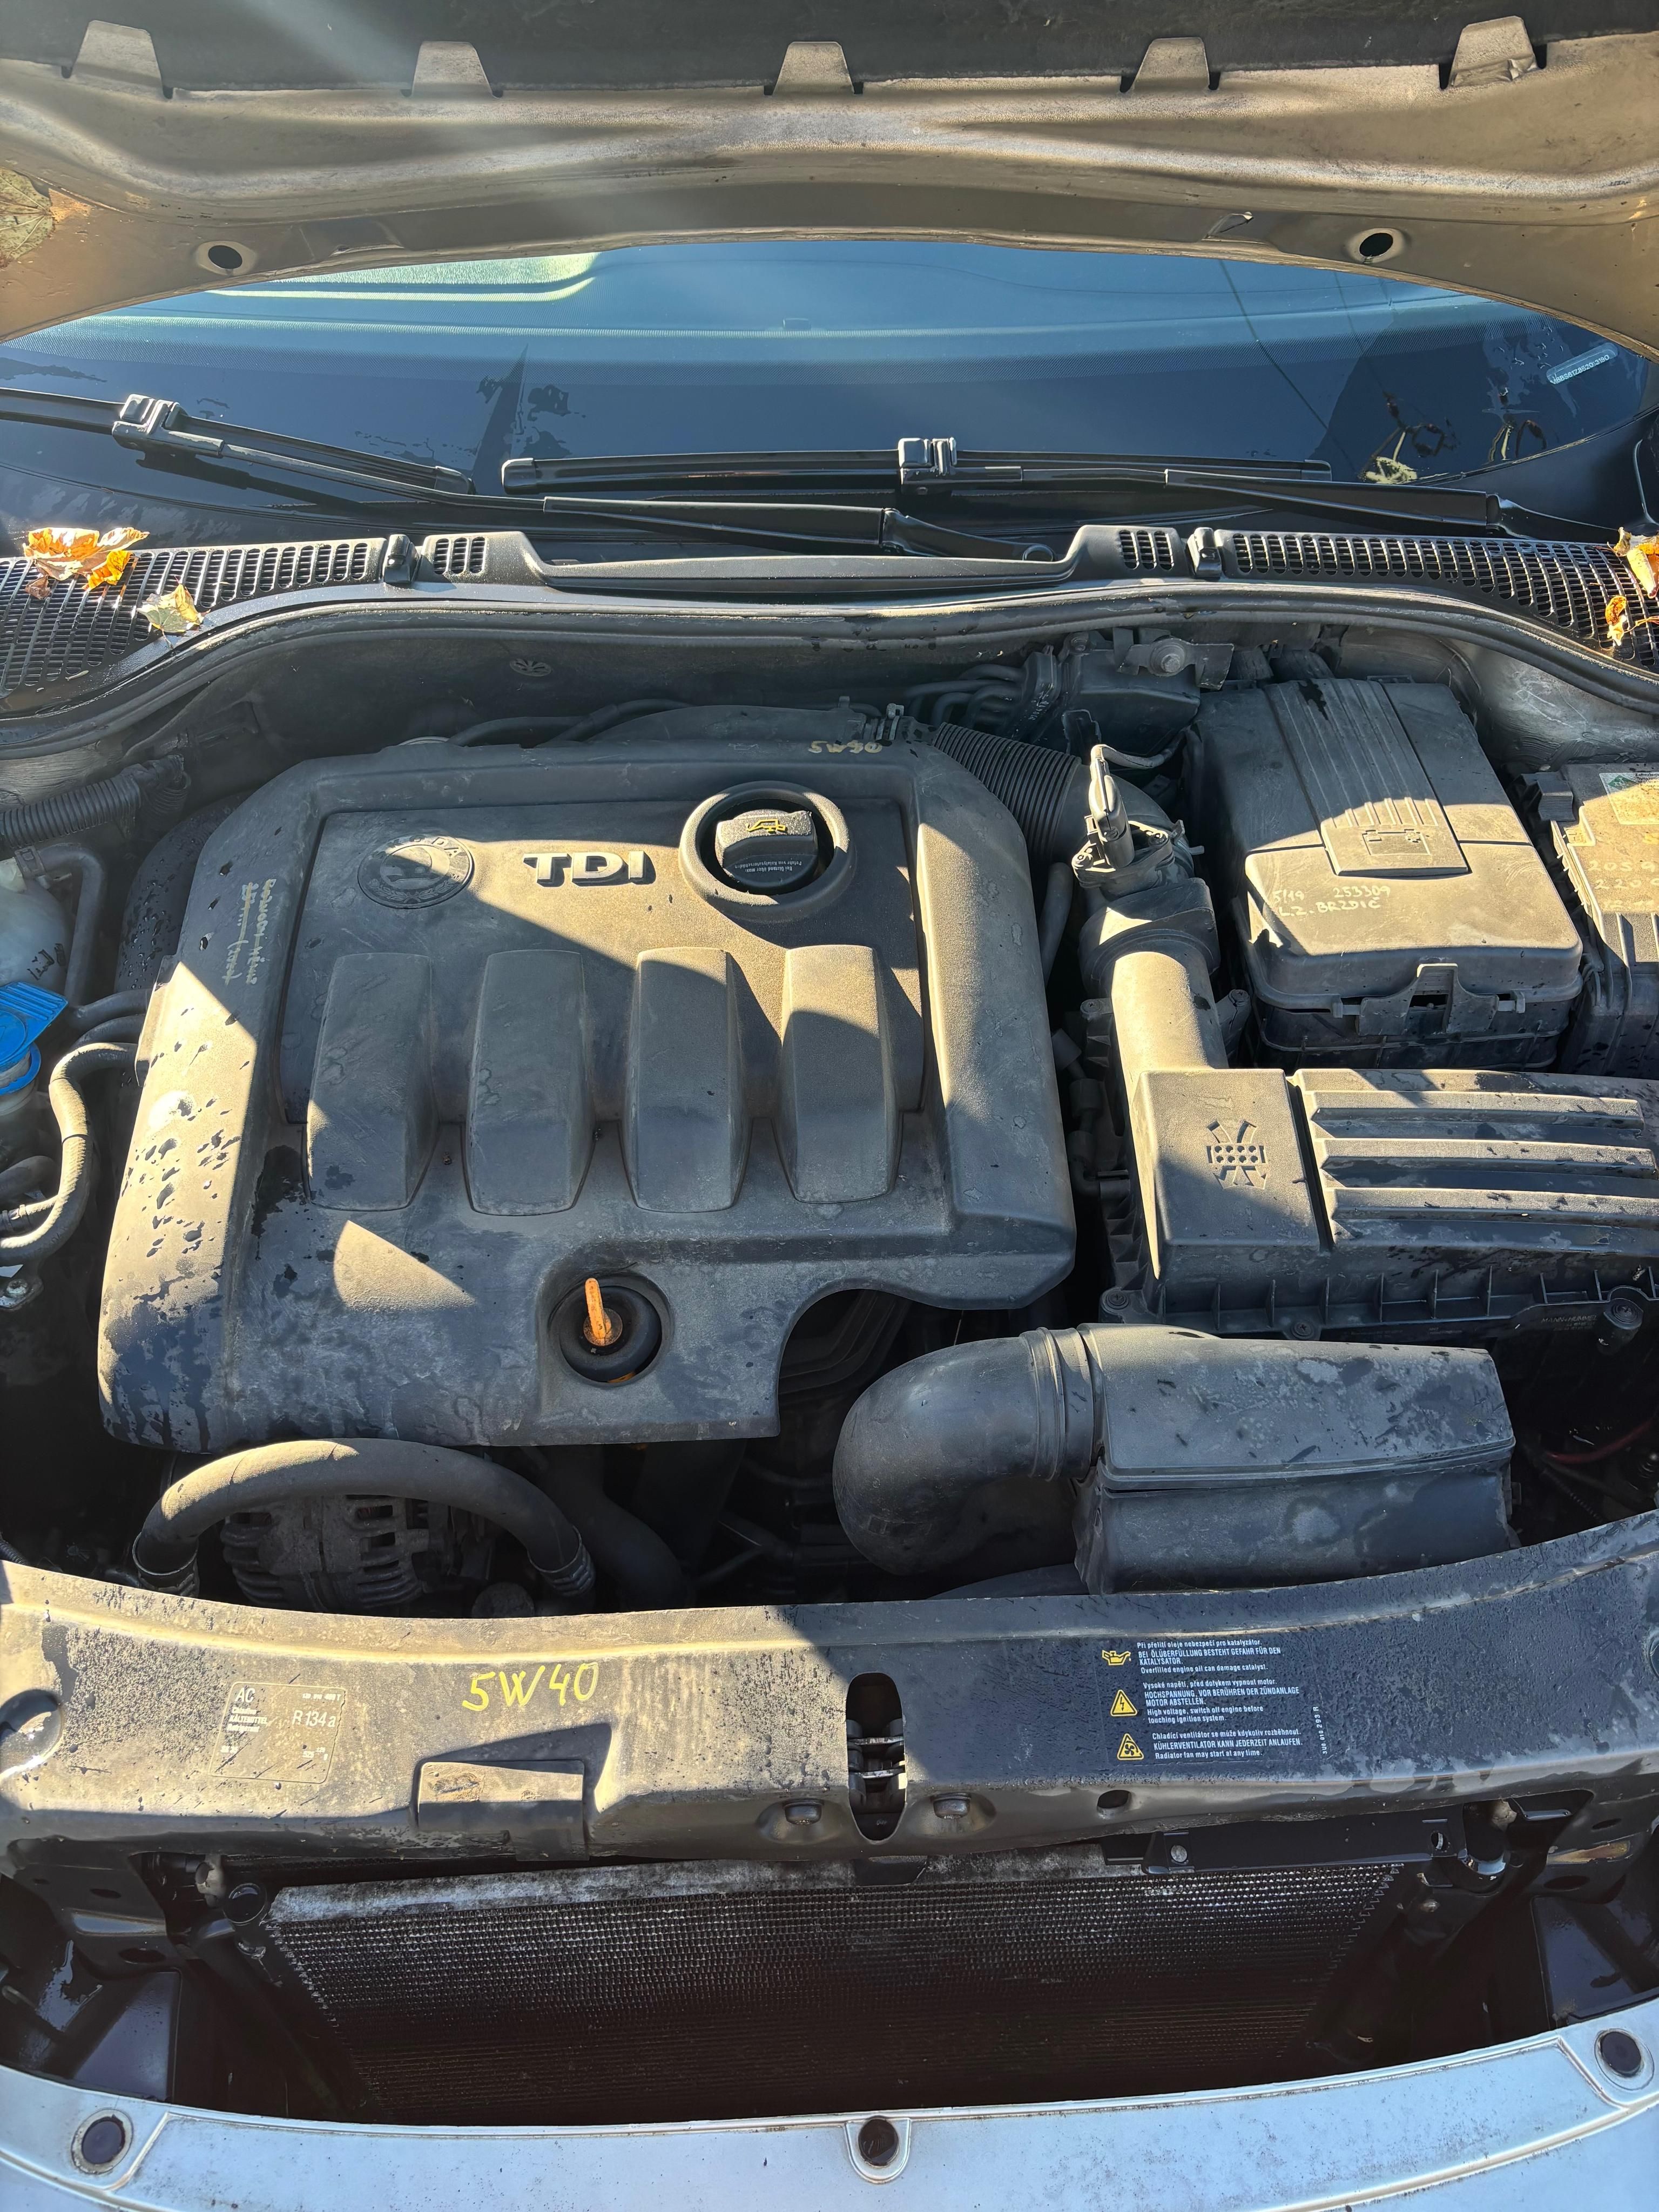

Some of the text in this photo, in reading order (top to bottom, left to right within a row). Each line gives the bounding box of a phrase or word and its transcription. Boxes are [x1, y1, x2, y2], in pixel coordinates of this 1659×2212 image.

[523, 851, 655, 886] TDI
[1151, 1648, 1203, 1658] ÖLÜBERFÜLLUNG
[1204, 1648, 1229, 1656] BESTEHT
[1231, 1647, 1255, 1655] GEFAHR
[1255, 1646, 1268, 1655] FÜR
[1139, 1657, 1183, 1665] KATALYSATOR.
[1172, 1665, 1194, 1674] engine
[1242, 1663, 1268, 1671] catalyst.
[1143, 1681, 1165, 1690] Vysoké
[1190, 1680, 1204, 1688] před
[1205, 1680, 1231, 1688] dotykem
[1232, 1678, 1256, 1687] vypnout
[234, 1687, 255, 1703] AC
[1212, 1687, 1245, 1696] BERÜHREN
[1259, 1686, 1299, 1695] ZÜNDANLAGE
[1145, 1697, 1206, 1707] MOTOR ABSTELLEN.
[1147, 1708, 1162, 1716] High
[1221, 1705, 1242, 1714] engine
[1148, 1714, 1227, 1724] touching ignition system.
[1152, 1731, 1178, 1739] Chladící
[1237, 1729, 1263, 1738] kdykoliv
[1154, 1737, 1303, 1750] KÜHLERVENTILATOR KANN JEDERZEIT ANLAUFEN.
